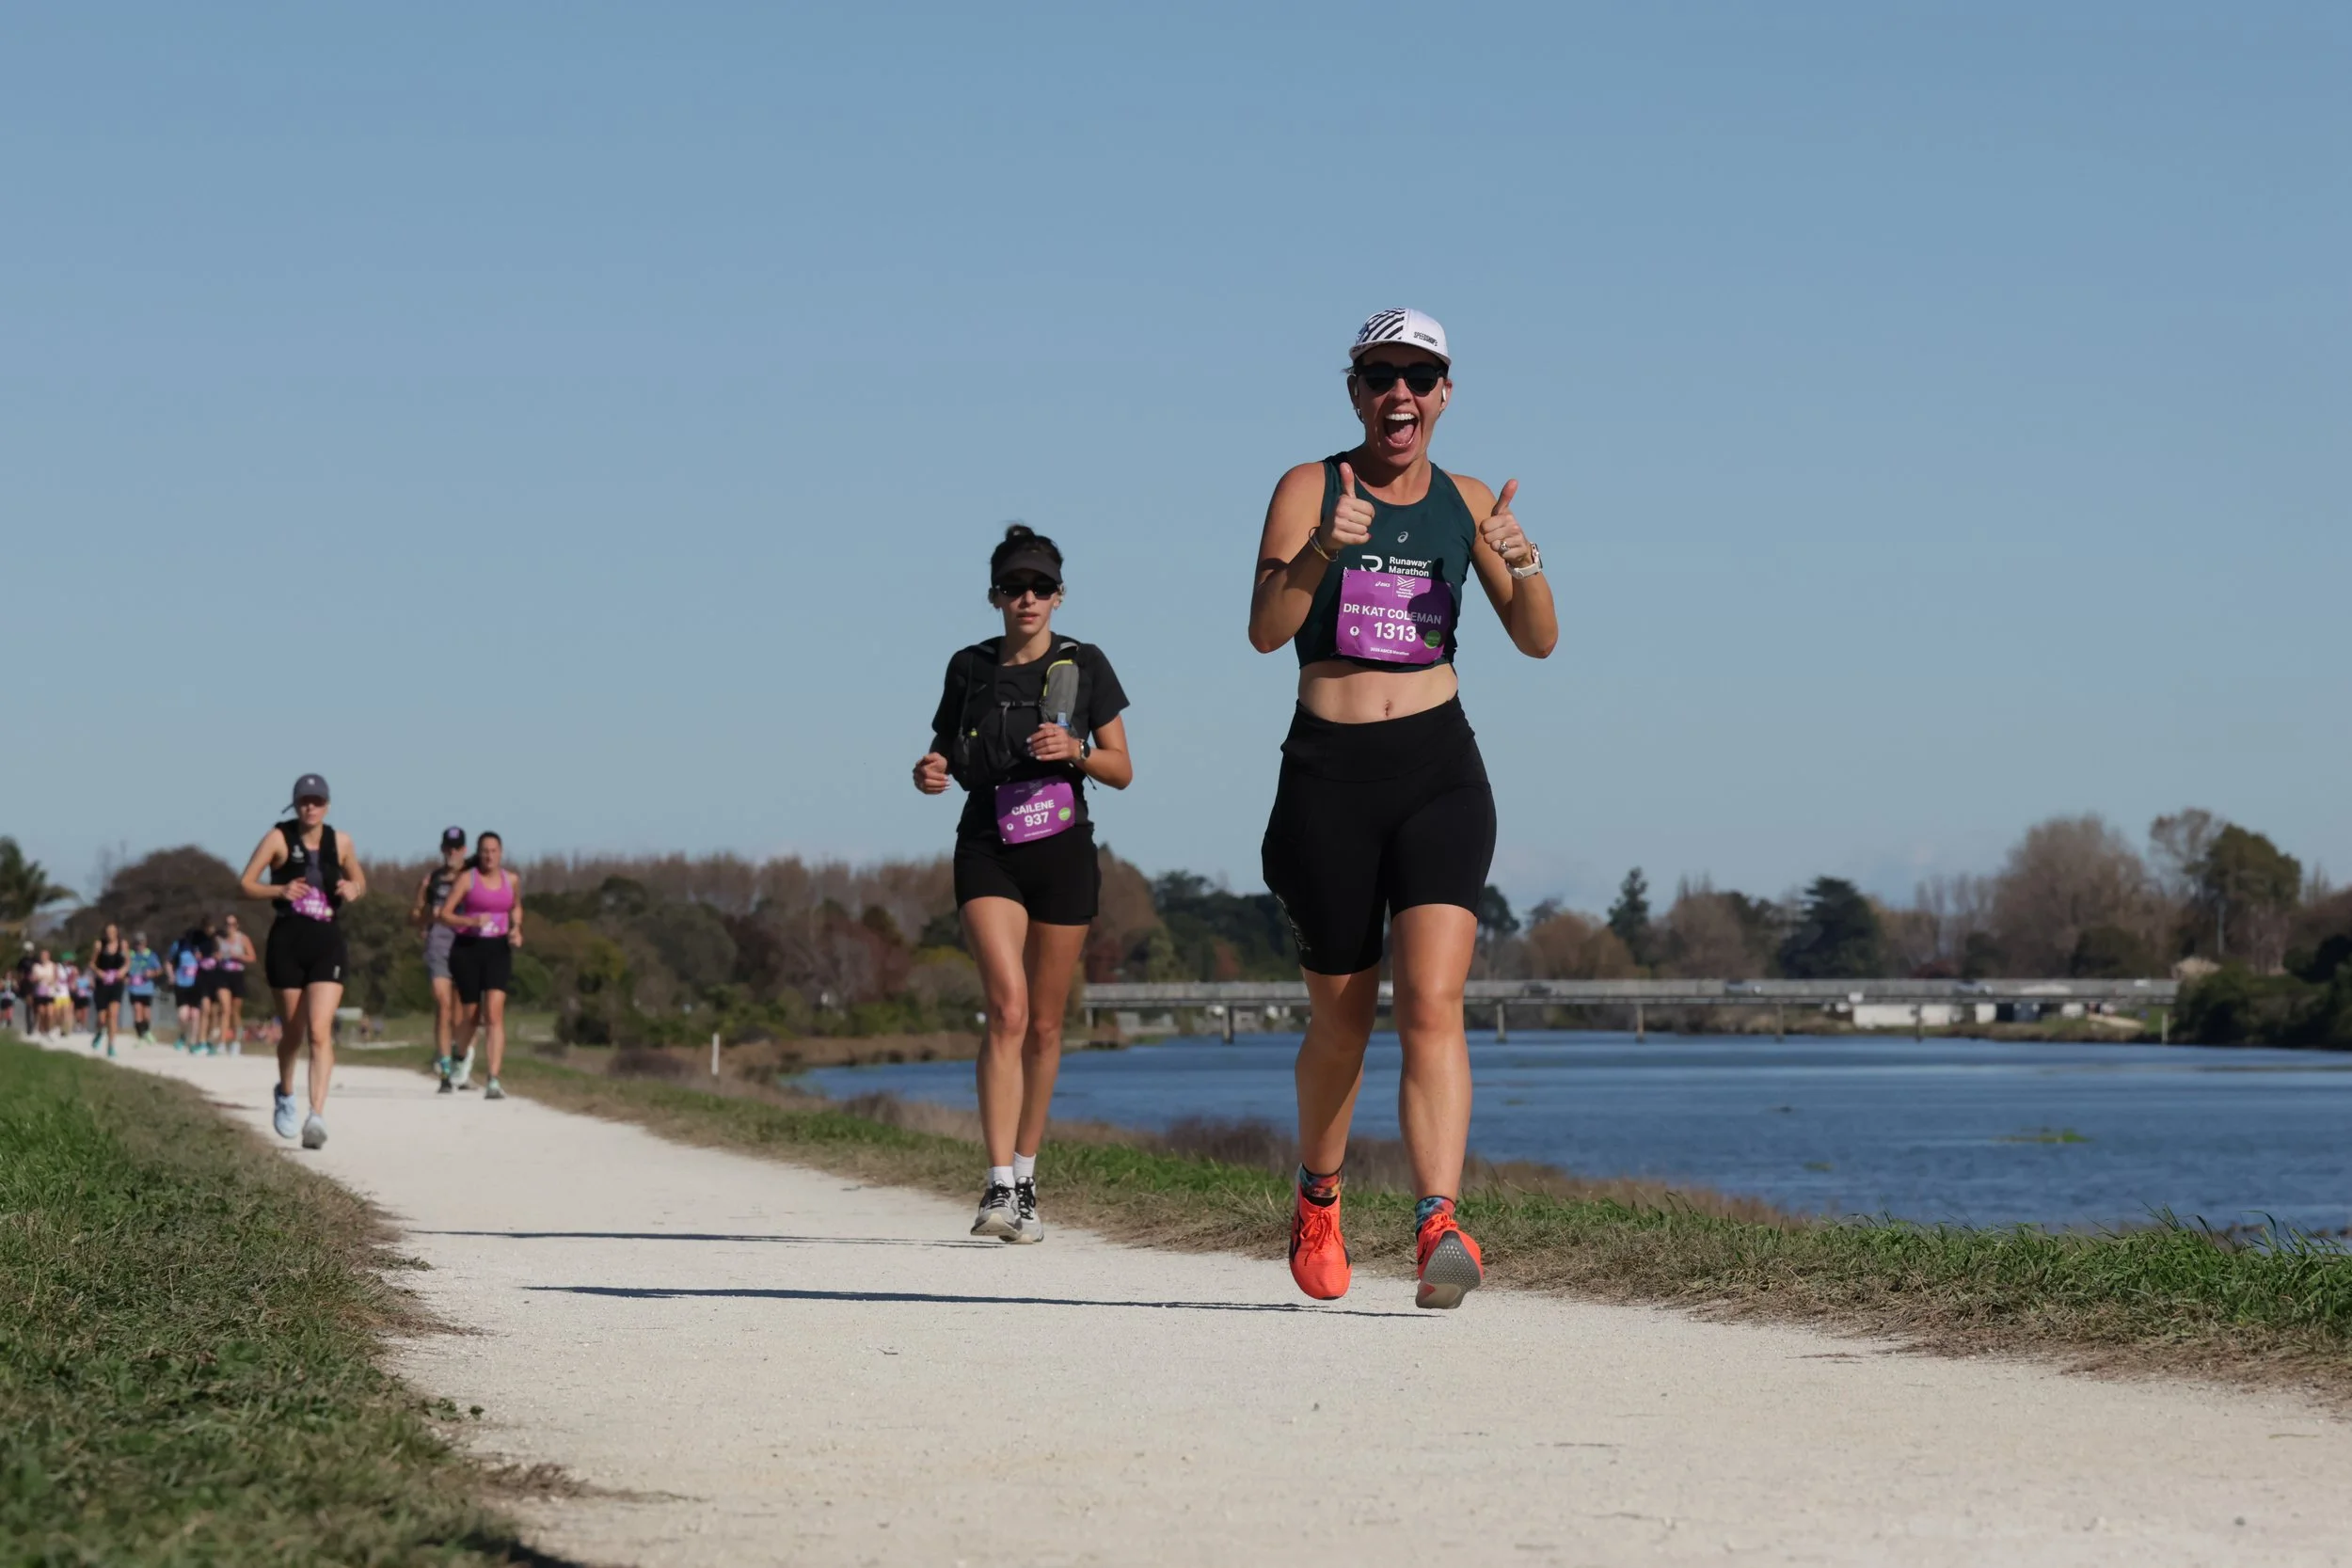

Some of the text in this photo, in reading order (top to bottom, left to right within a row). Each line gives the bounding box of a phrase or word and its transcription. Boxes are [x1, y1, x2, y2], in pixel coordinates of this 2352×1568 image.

[1388, 565, 1429, 577] Marathon
[1343, 603, 1442, 625] DR KAT COLEMAN
[1374, 622, 1417, 642] 1313
[1011, 800, 1056, 816] CAILENE
[1024, 812, 1049, 828] 937
